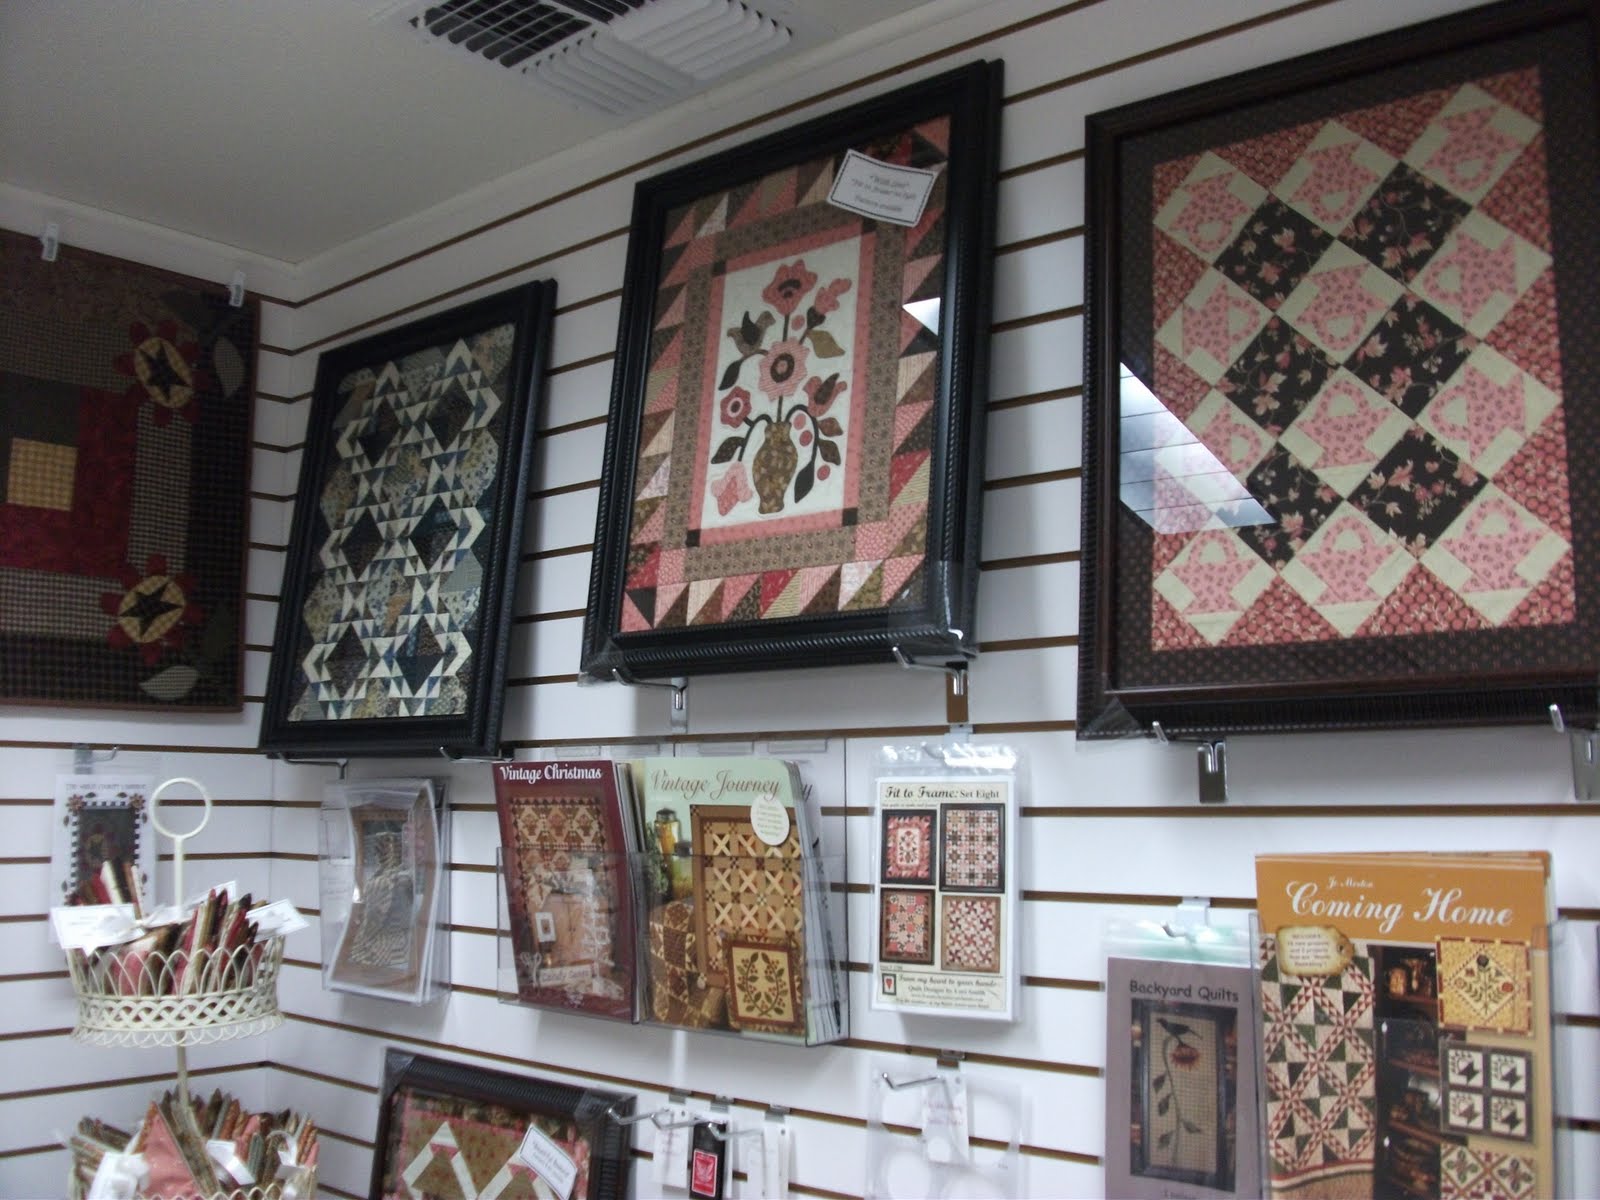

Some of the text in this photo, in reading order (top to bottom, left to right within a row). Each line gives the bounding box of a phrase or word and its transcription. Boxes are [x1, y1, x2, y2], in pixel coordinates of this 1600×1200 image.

[500, 763, 602, 785] Vintage Christmas
[650, 769, 709, 800] Vintage
[710, 769, 781, 801] Journey
[885, 786, 900, 799] Fit
[903, 787, 913, 798] to
[960, 789, 973, 799] Set
[976, 789, 1000, 800] Eight
[1286, 880, 1514, 934] Coming Home
[1129, 979, 1240, 1003] Backyard Quilts
